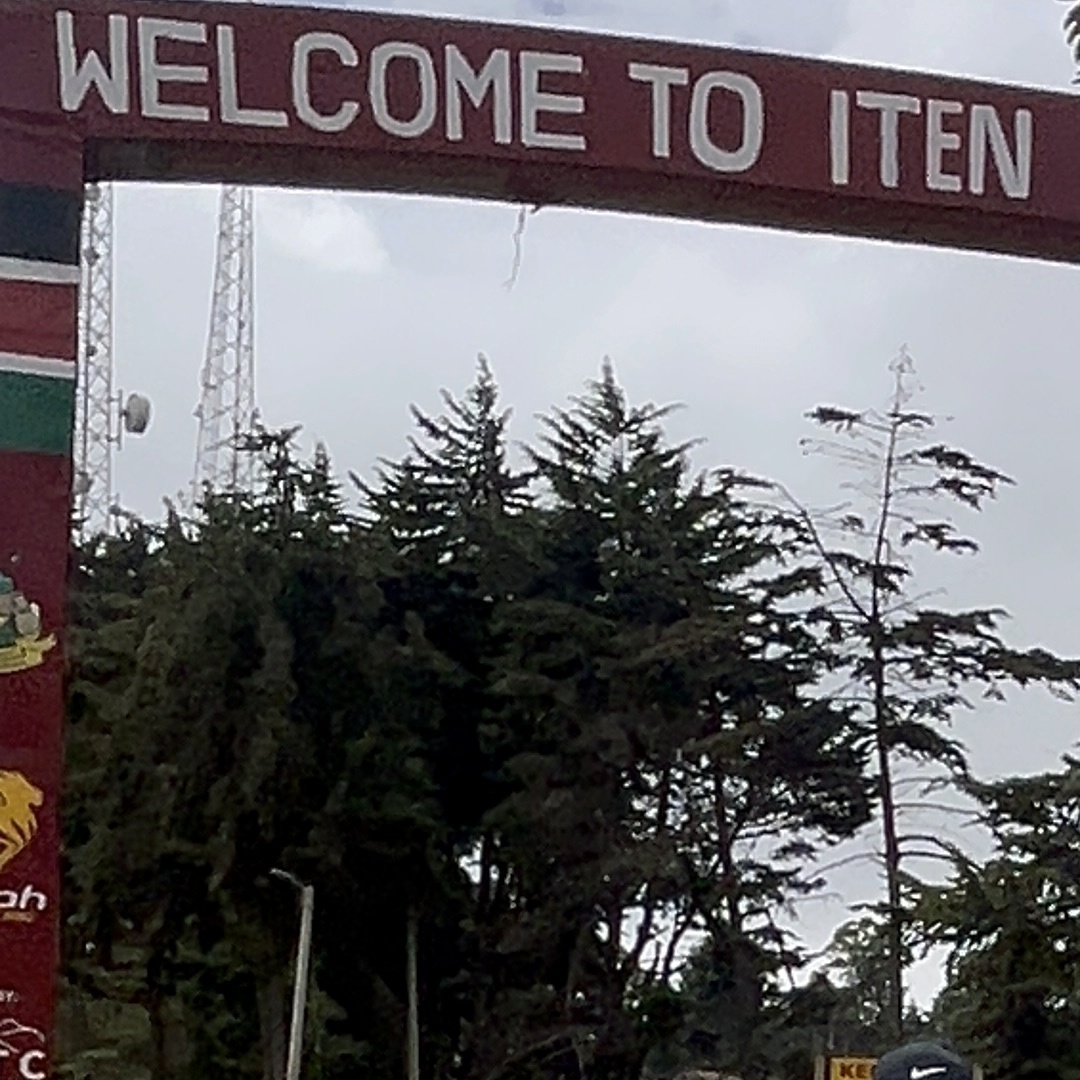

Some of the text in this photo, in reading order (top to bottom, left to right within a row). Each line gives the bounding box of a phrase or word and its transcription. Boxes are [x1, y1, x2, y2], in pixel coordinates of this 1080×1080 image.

[56, 10, 587, 151] WELCOME
[629, 62, 764, 173] TO
[829, 89, 1033, 199] ITEN
